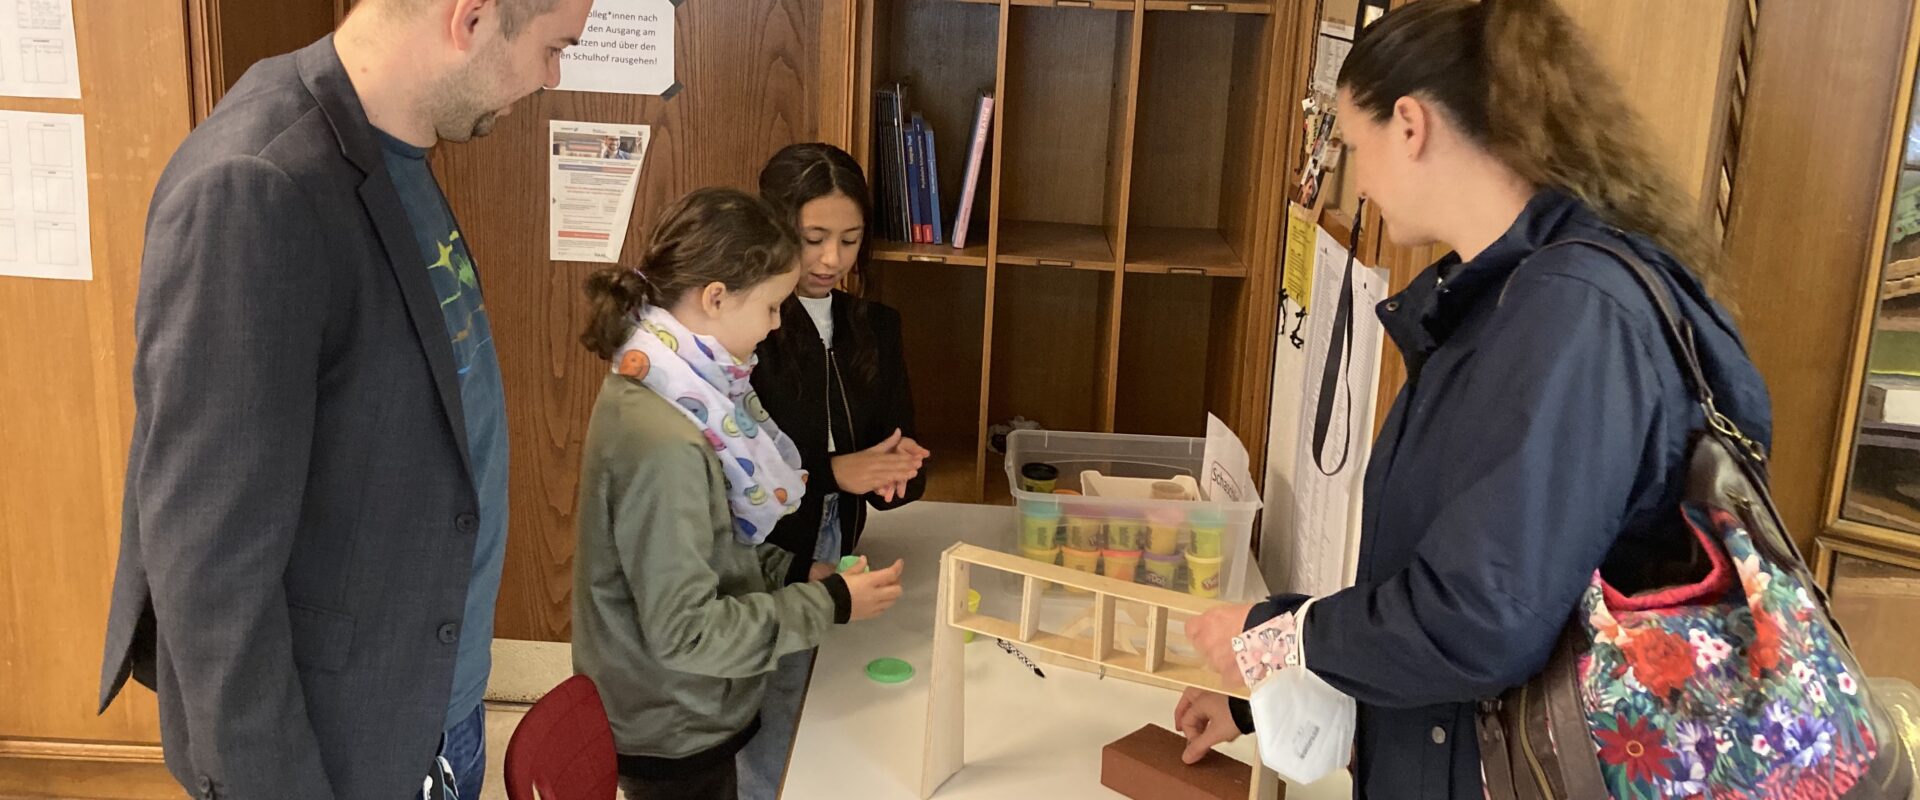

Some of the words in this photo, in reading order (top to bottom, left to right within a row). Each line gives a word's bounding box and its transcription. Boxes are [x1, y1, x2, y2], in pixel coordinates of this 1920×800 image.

[588, 10, 636, 21] olleginnen
[638, 13, 658, 22] nach
[587, 24, 604, 33] den
[606, 25, 641, 37] Ausgang
[600, 40, 617, 48] und
[619, 40, 638, 50] über
[640, 42, 656, 51] den
[560, 52, 571, 60] en
[573, 51, 610, 62] Schulhof
[611, 56, 658, 66] rausgehen!
